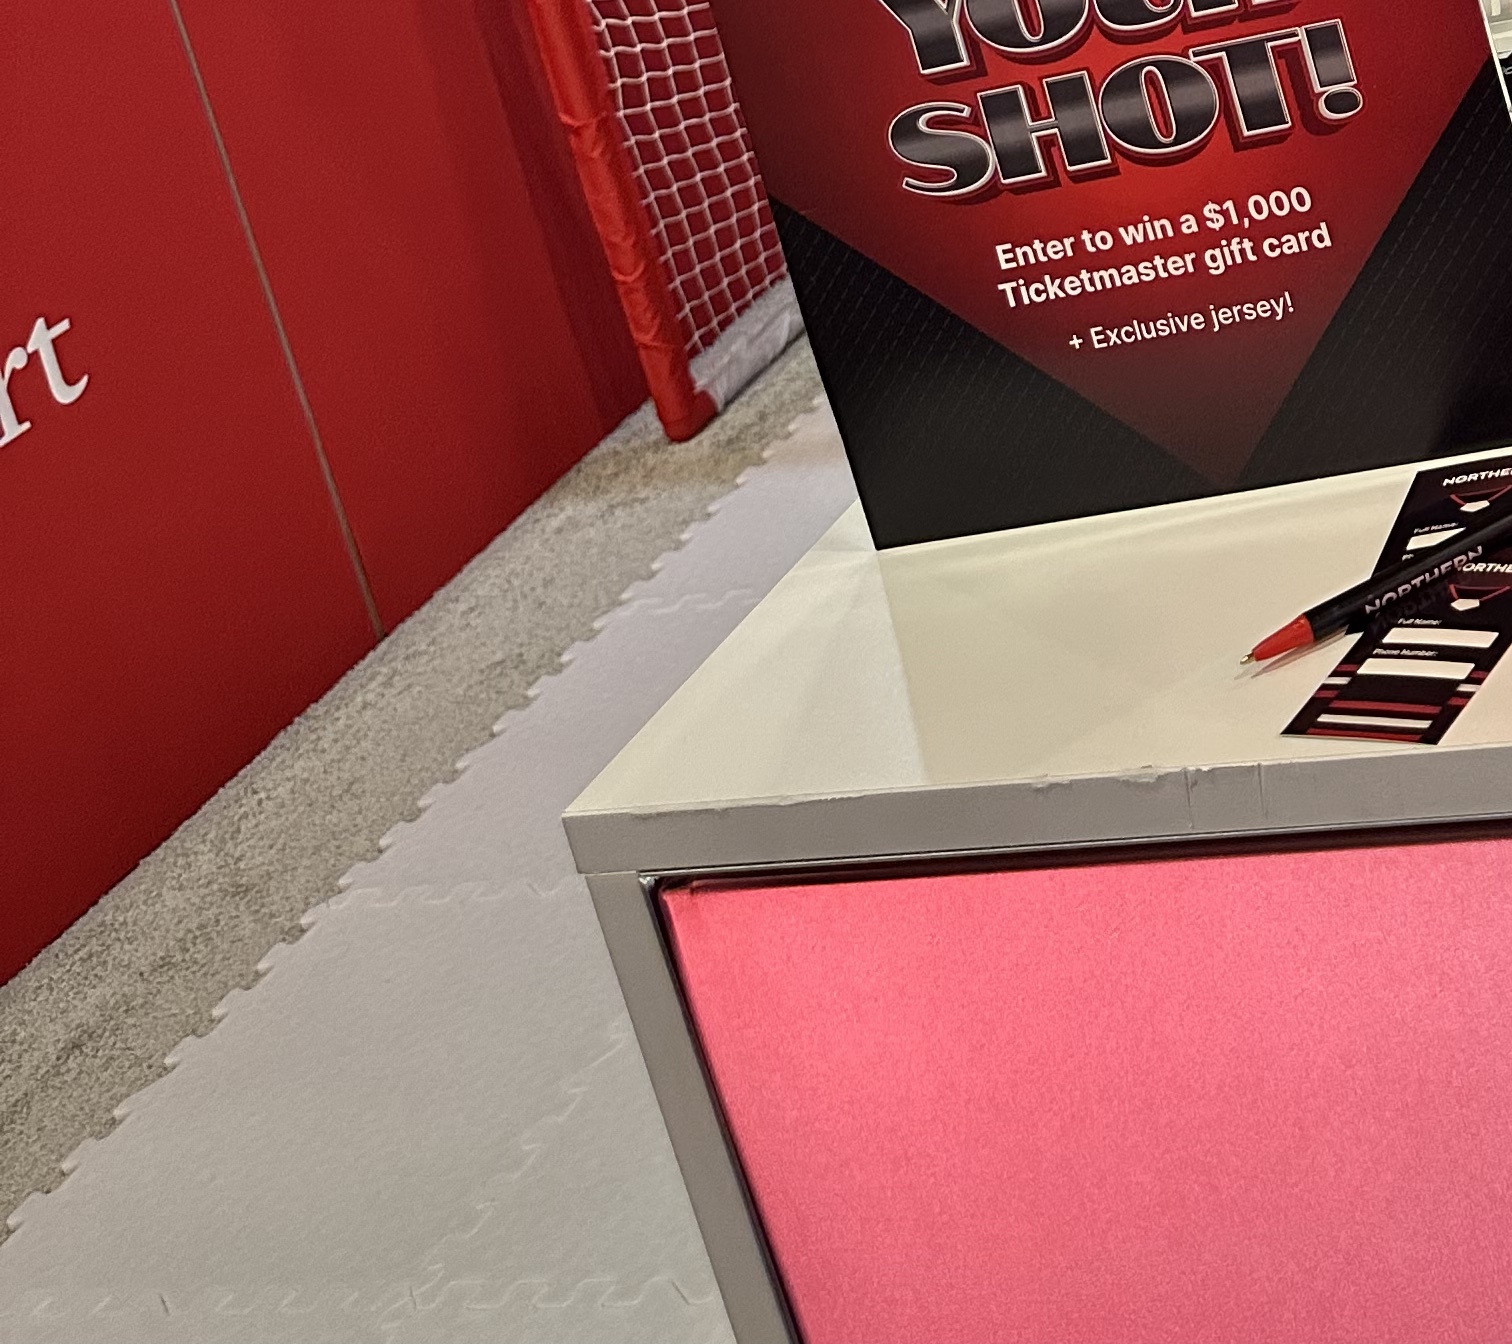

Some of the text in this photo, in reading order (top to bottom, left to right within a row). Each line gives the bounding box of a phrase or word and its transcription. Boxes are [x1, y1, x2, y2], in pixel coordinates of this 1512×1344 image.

[888, 19, 1364, 197] SHOT!
[995, 186, 1313, 271] Enter to win a $1,000
[997, 222, 1333, 309] Ticketmaster gift card
[1090, 310, 1206, 350] Exclusive
[1209, 291, 1296, 332] jersey!
